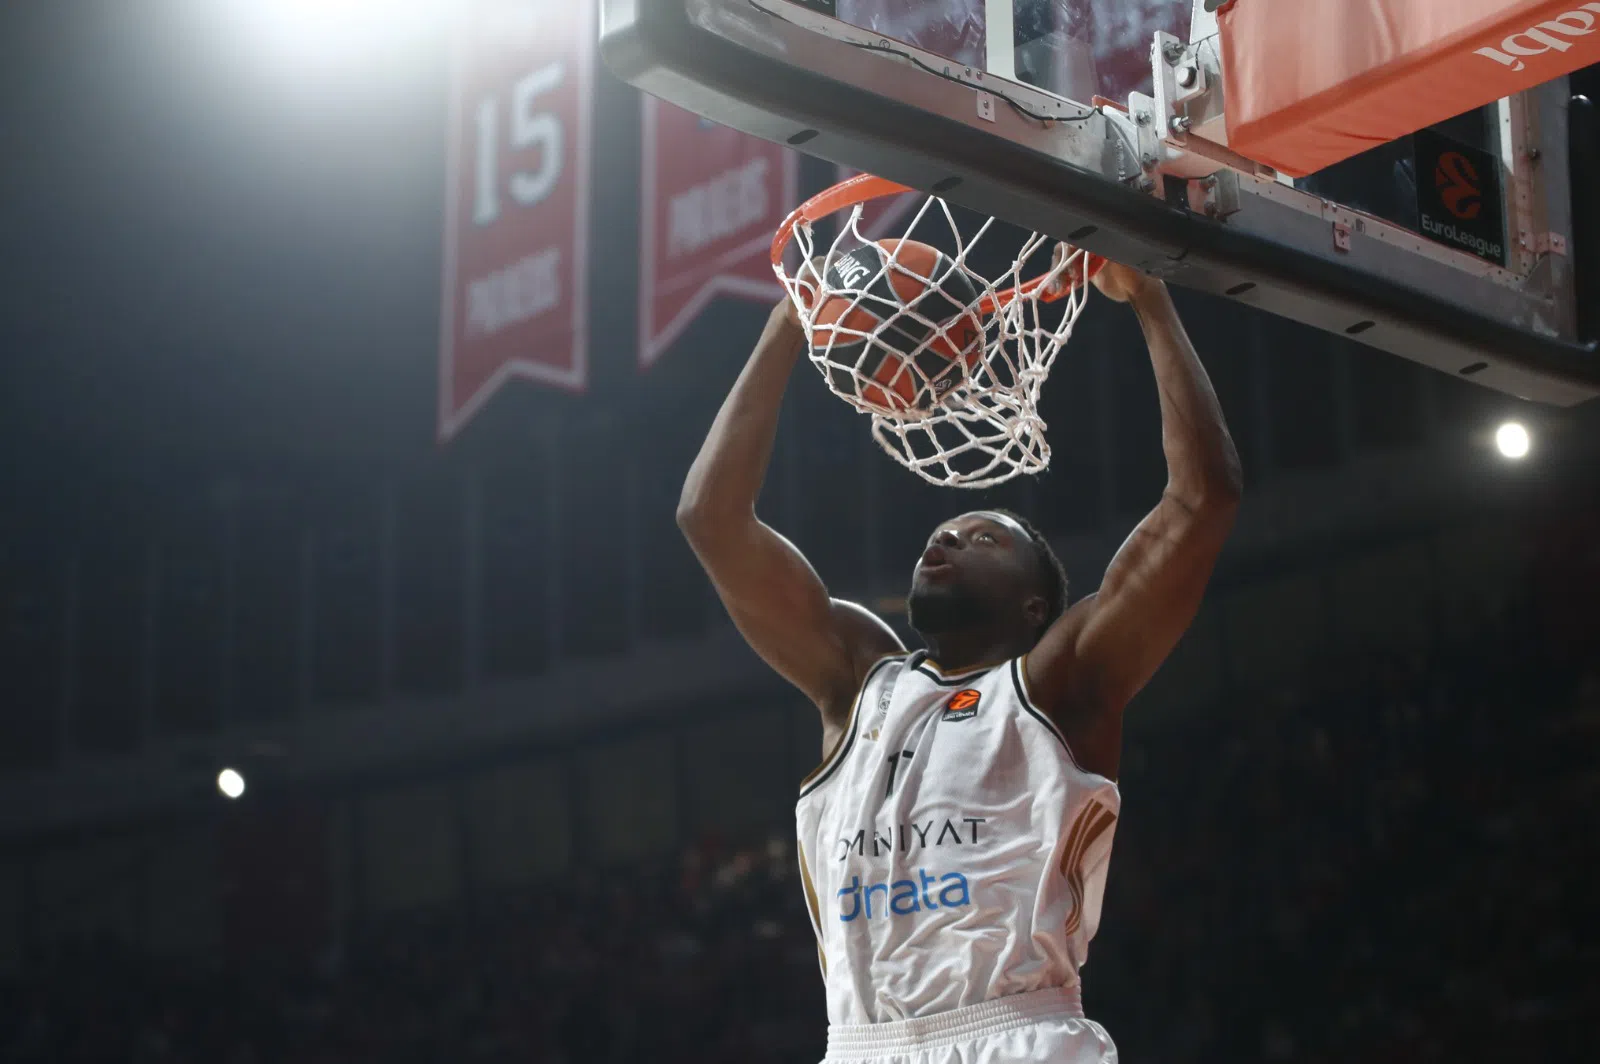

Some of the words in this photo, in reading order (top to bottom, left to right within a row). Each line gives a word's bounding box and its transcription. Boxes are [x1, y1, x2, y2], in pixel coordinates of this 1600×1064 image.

[1472, 2, 1600, 72] abi
[472, 60, 565, 227] 15
[1421, 213, 1501, 258] EuroLeague
[885, 750, 915, 799] 1
[837, 868, 970, 922] dnata
